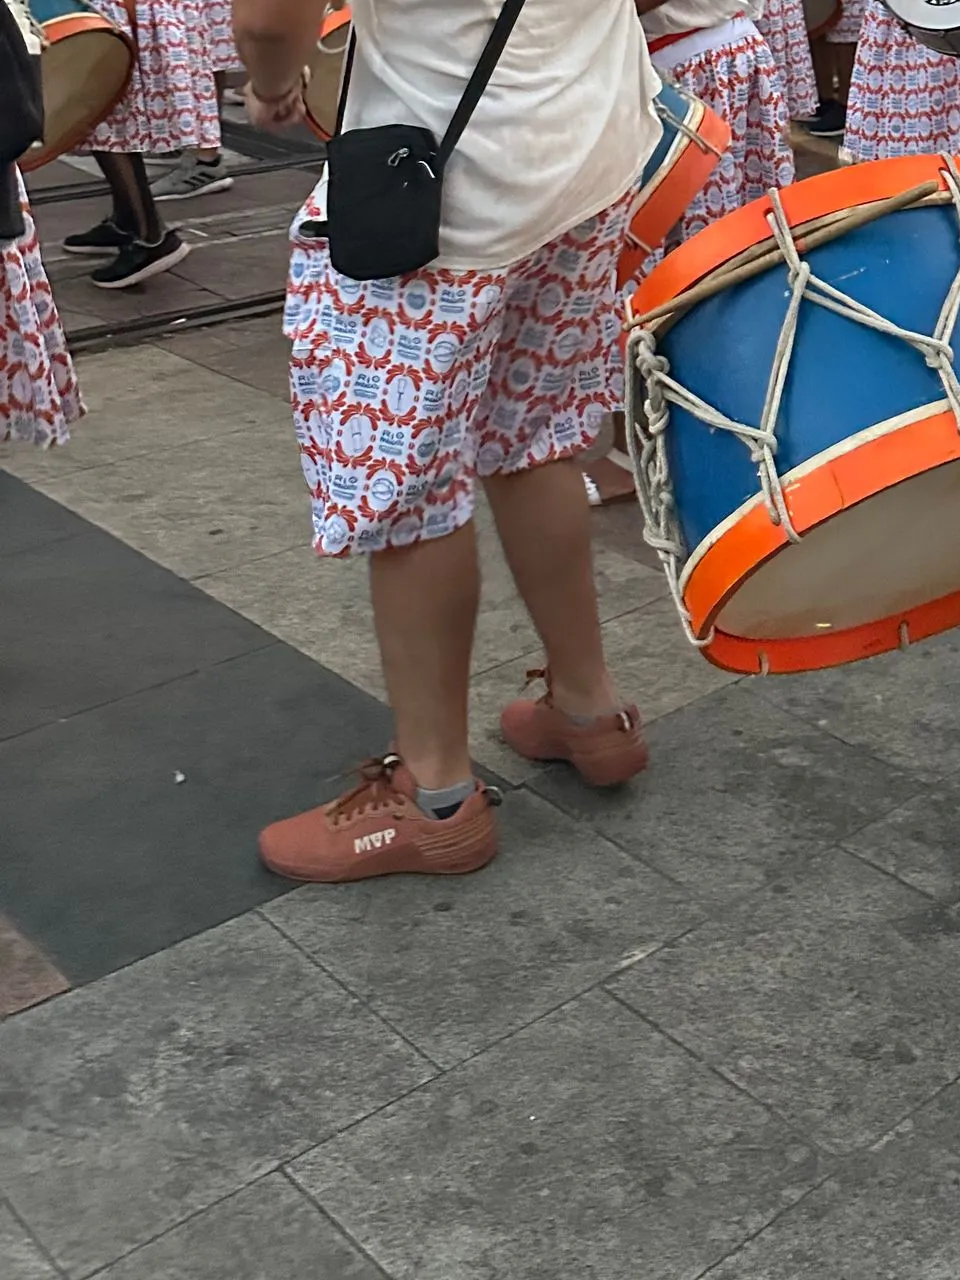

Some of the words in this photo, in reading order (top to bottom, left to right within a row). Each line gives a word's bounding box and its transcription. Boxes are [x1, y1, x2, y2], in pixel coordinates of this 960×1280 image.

[358, 373, 380, 382] RIO
[382, 429, 404, 439] RIO
[354, 828, 396, 854] MVP
